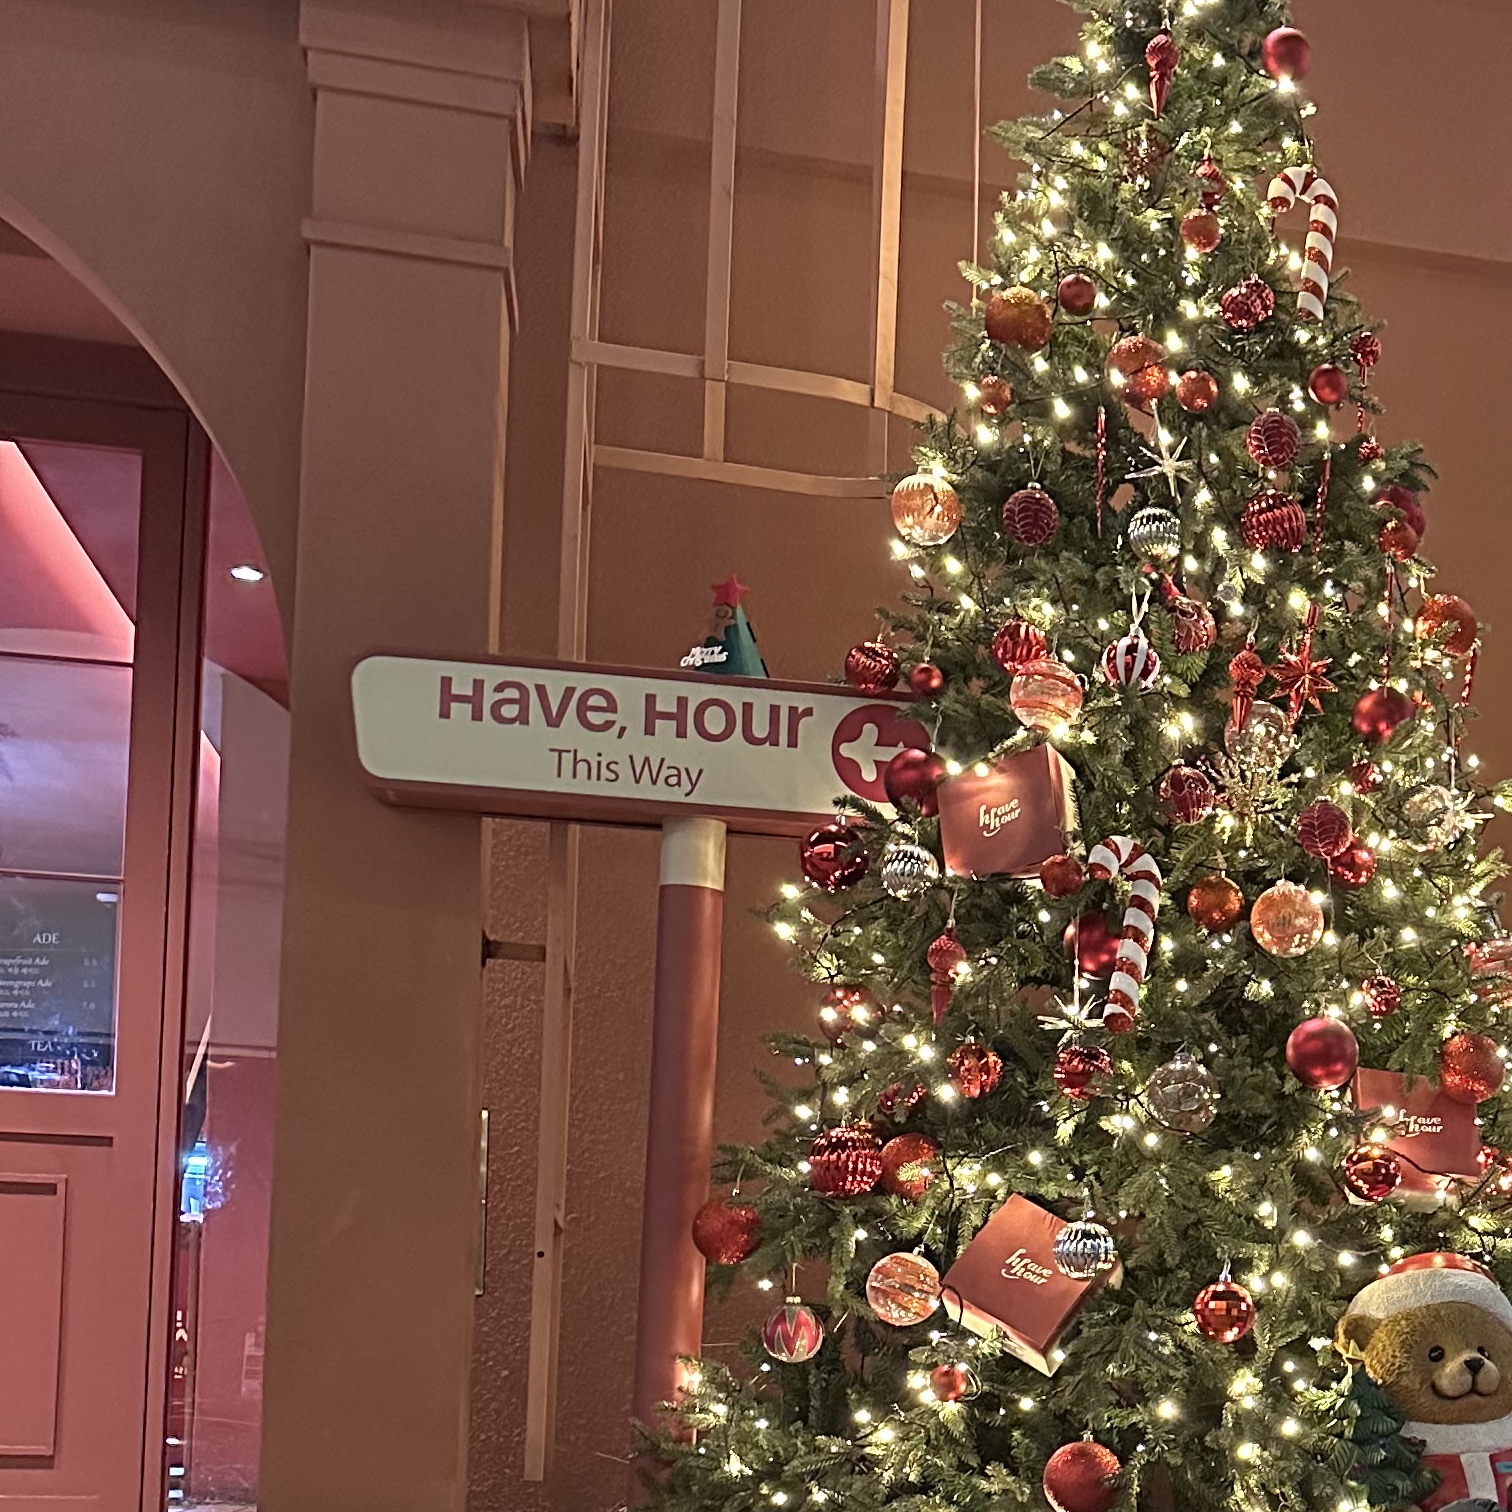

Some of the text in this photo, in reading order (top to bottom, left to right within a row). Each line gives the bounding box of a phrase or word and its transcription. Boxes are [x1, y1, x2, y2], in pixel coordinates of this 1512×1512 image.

[438, 675, 814, 749] Have, Hour
[549, 748, 703, 797] This Way
[33, 932, 60, 944] ADE
[30, 1040, 54, 1052] TEA
